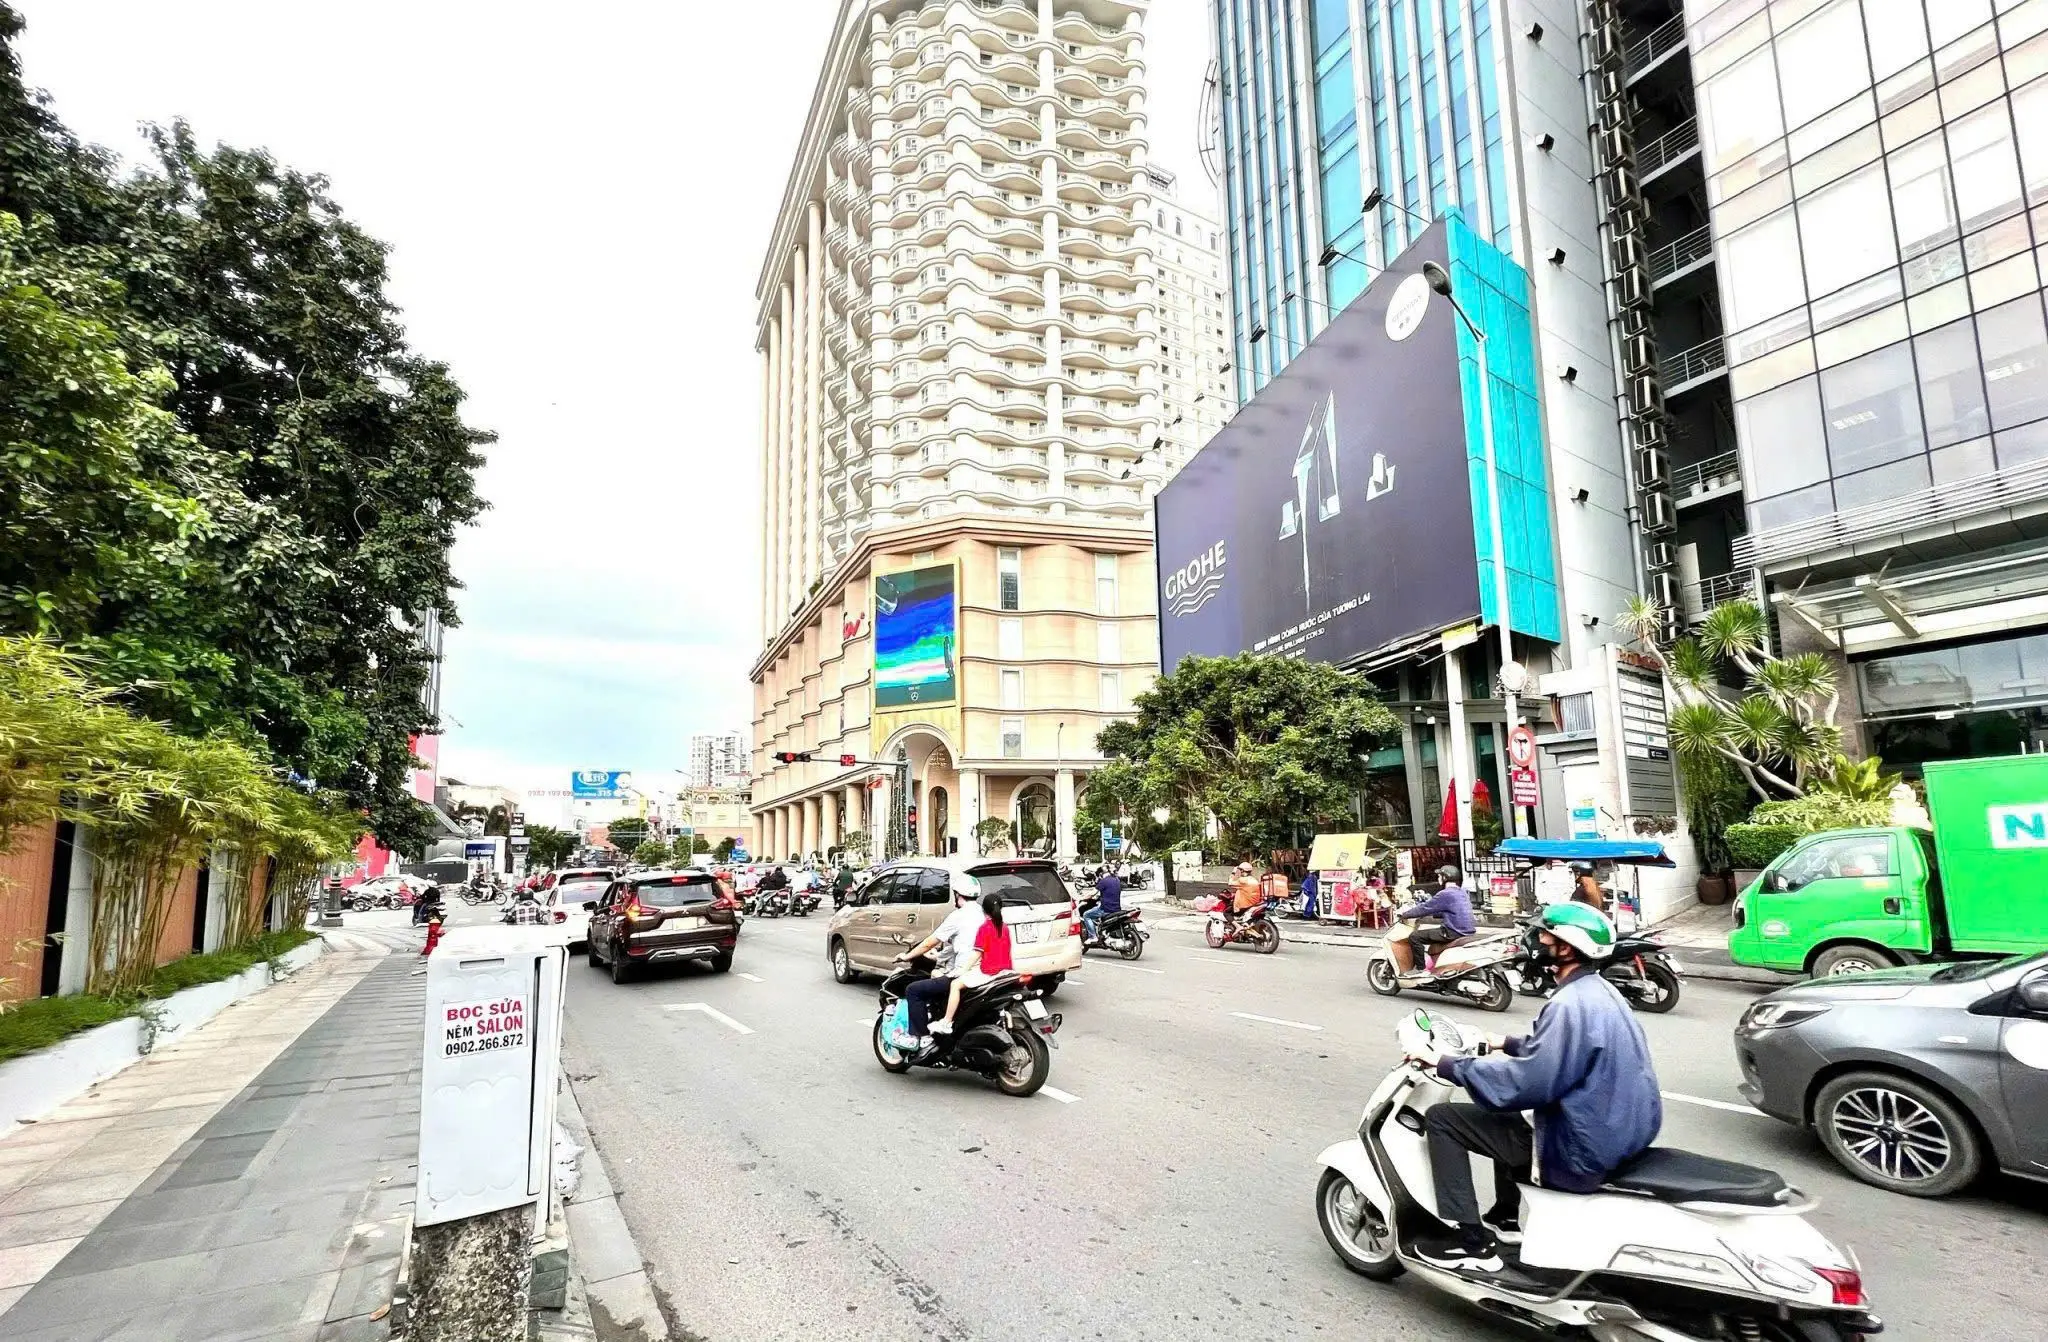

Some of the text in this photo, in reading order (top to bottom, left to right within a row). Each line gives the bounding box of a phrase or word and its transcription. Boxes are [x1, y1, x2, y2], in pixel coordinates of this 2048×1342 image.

[1165, 539, 1226, 600] GROHE
[447, 998, 523, 1021] BỌC SỬA
[446, 1015, 523, 1040] NỆM SALON
[446, 1033, 523, 1055] 0902.266.872
